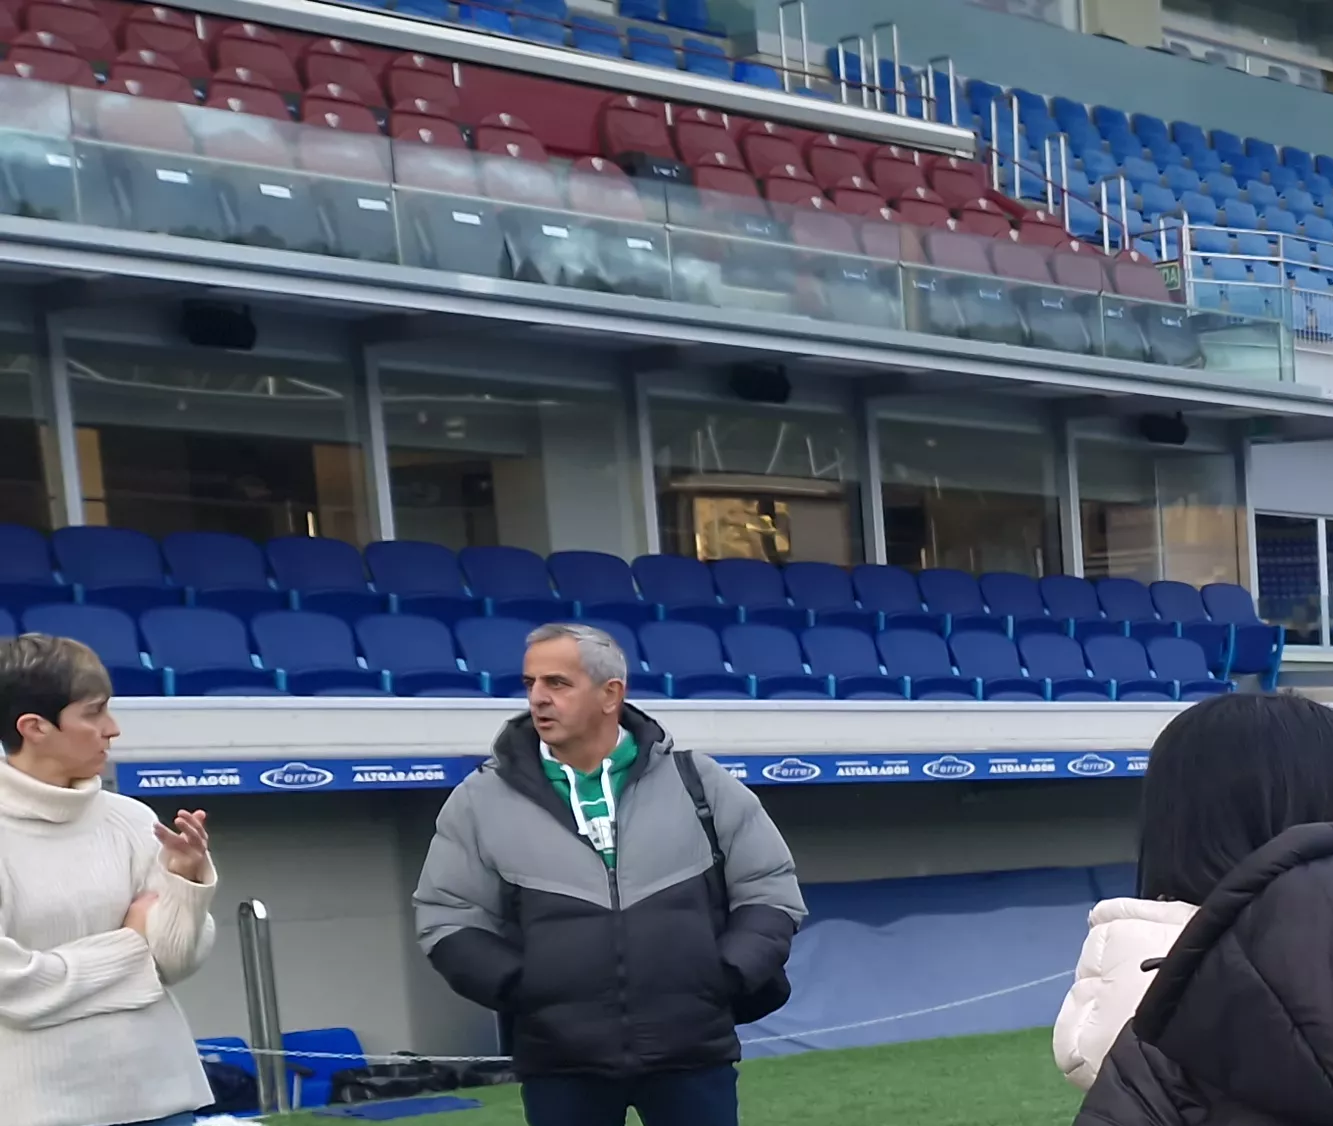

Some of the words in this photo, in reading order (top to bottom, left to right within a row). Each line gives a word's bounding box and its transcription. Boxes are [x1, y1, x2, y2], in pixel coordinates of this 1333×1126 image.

[772, 766, 813, 777] Ferrer
[931, 763, 968, 774] Ferrer
[1075, 762, 1108, 771] Ferrer
[272, 771, 323, 784] Ferrer
